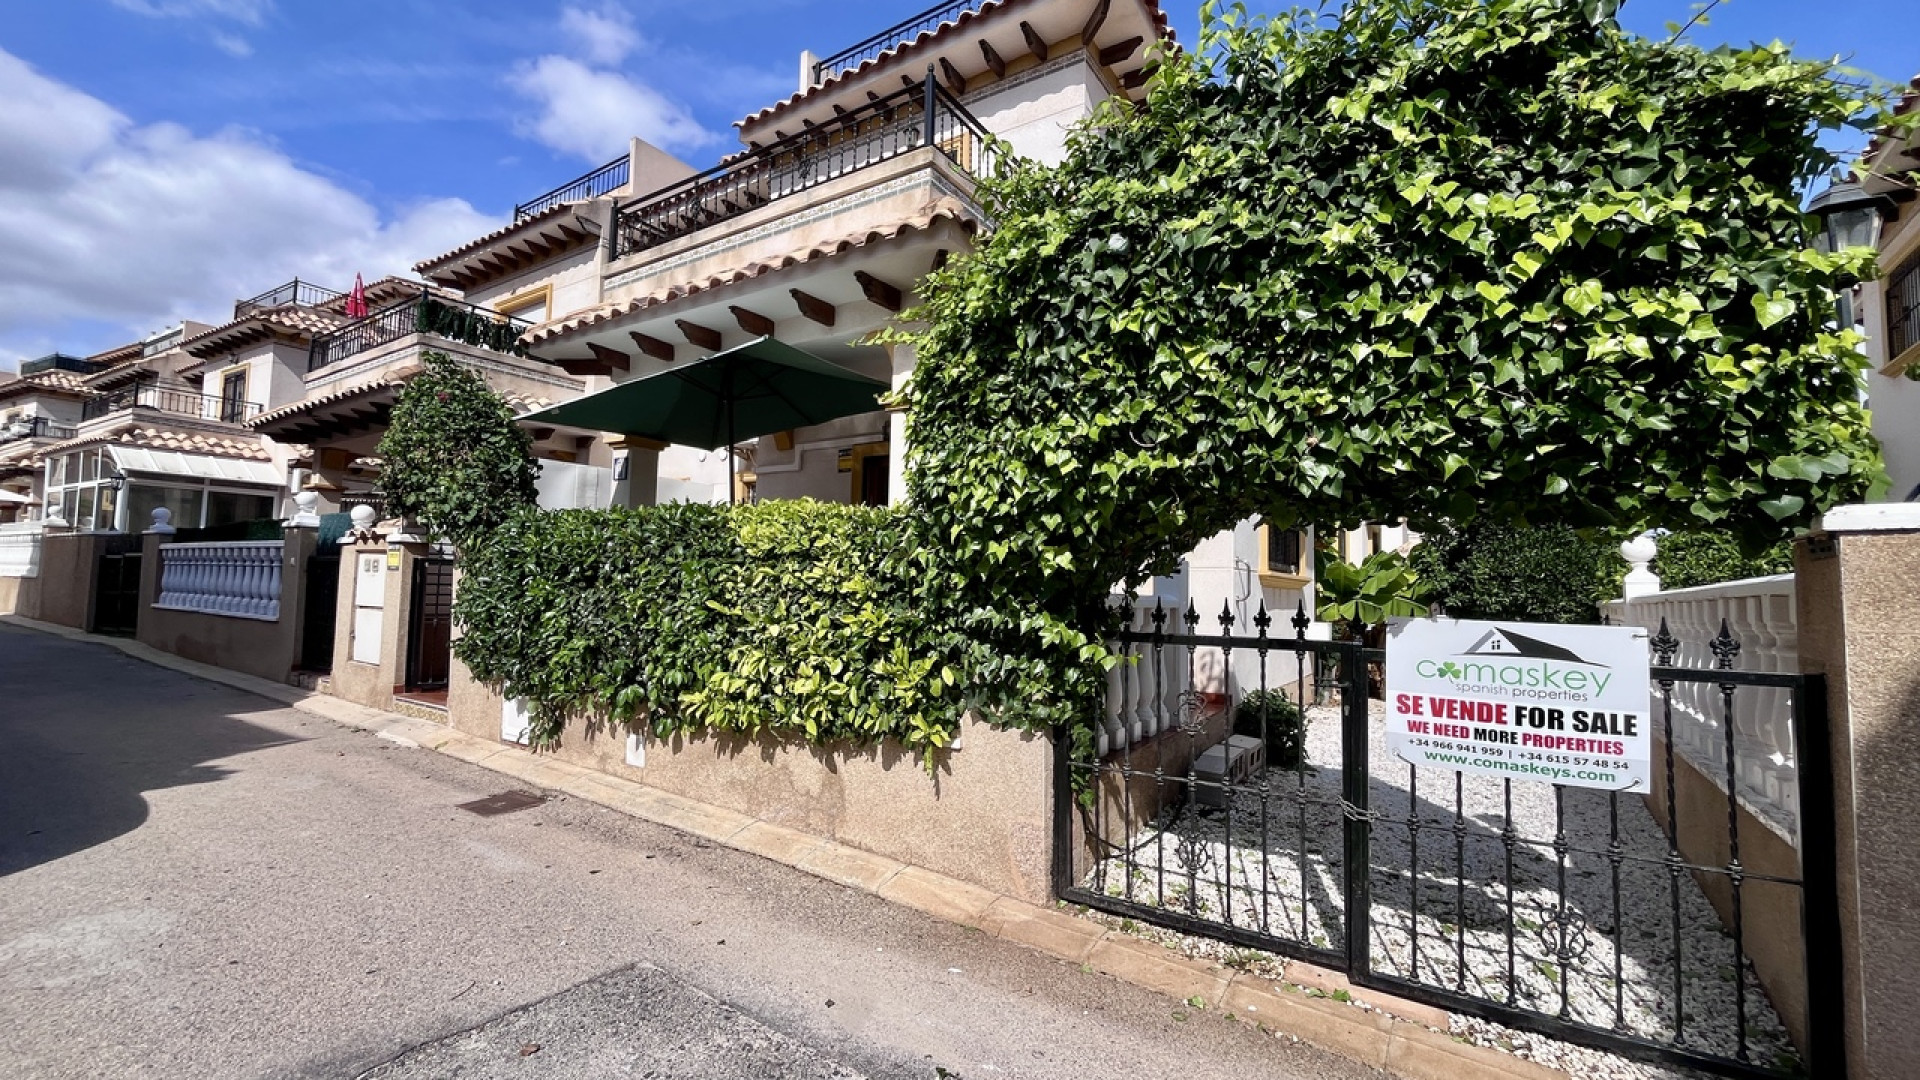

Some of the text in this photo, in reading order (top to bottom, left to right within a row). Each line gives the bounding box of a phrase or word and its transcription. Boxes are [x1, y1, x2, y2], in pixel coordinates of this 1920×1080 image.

[1456, 682, 1588, 702] spanish properties
[1396, 693, 1638, 737] SE VENDE FOR SALE
[1407, 720, 1624, 756] WE NEED MORE PROPERTIES
[1408, 738, 1429, 747] +34
[1432, 740, 1453, 751] 966
[1456, 743, 1478, 754] 941
[1481, 746, 1503, 757] 959
[1518, 752, 1542, 761] +34
[1546, 754, 1569, 764] 615
[1574, 757, 1589, 766] 57
[1592, 759, 1609, 769] 48
[1613, 761, 1629, 769] 54
[1425, 751, 1616, 782] www.comaskeys.com
